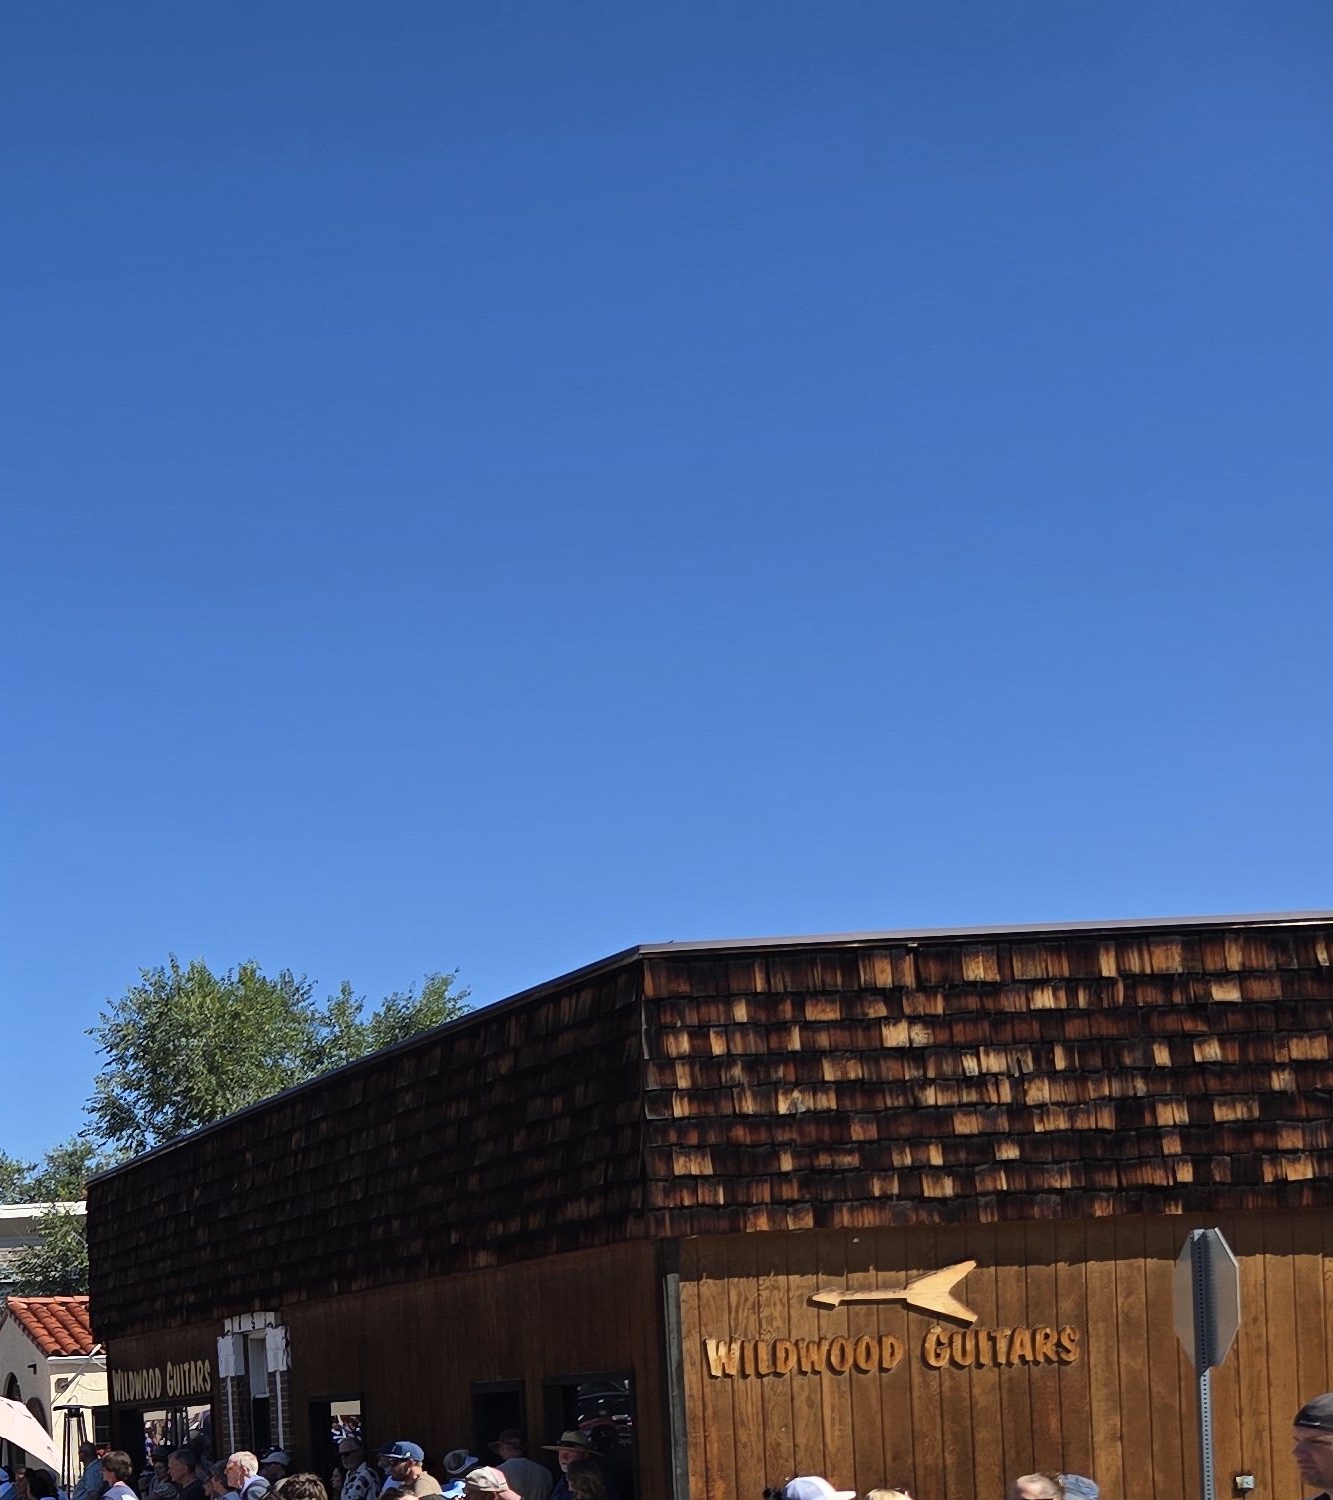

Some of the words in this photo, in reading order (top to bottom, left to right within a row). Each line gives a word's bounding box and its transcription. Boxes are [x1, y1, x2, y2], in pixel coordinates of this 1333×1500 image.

[704, 1333, 904, 1379] WILDWOOD
[922, 1323, 1082, 1370] GUITARS
[112, 1367, 162, 1402] WILDWOOD
[166, 1359, 212, 1397] GUITARS
